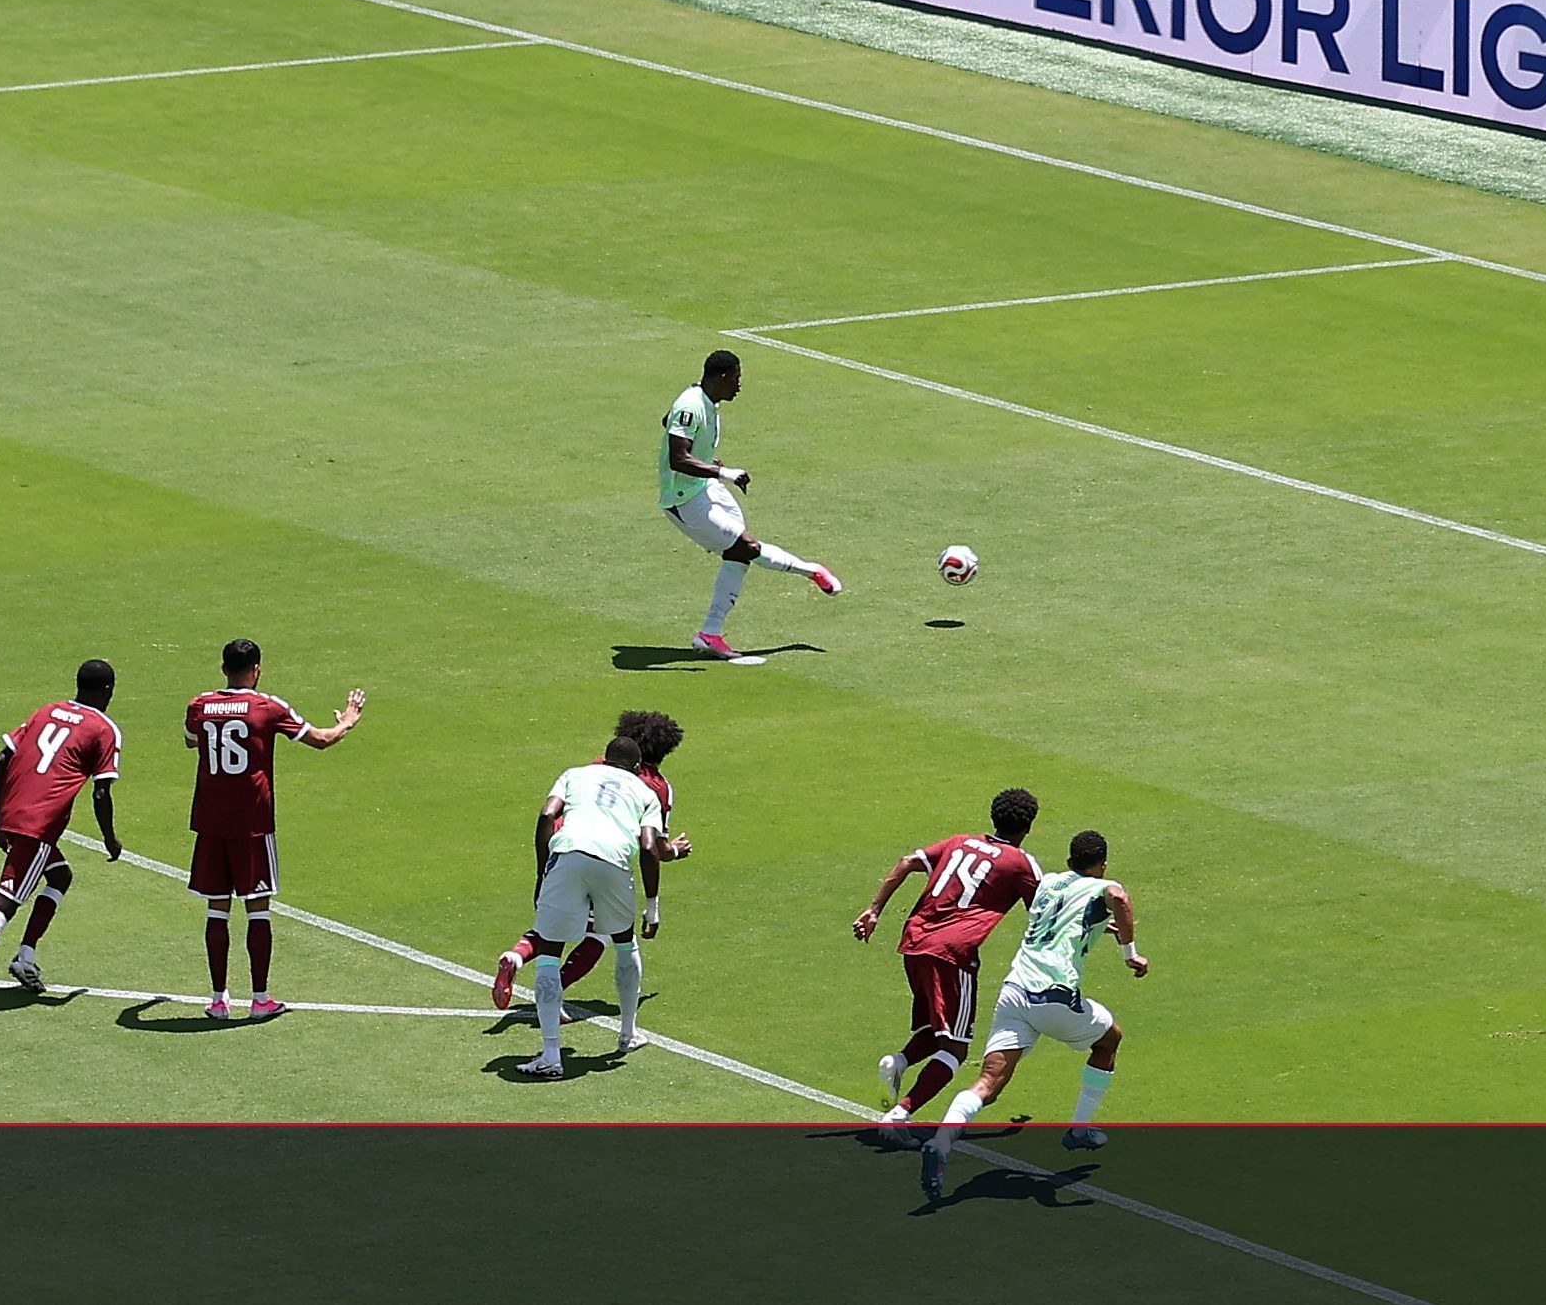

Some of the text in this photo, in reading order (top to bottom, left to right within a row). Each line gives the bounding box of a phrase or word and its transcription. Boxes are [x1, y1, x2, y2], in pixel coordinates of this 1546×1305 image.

[36, 722, 71, 774] 4
[203, 719, 249, 775] 16
[596, 780, 621, 808] 6
[931, 848, 993, 909] 14
